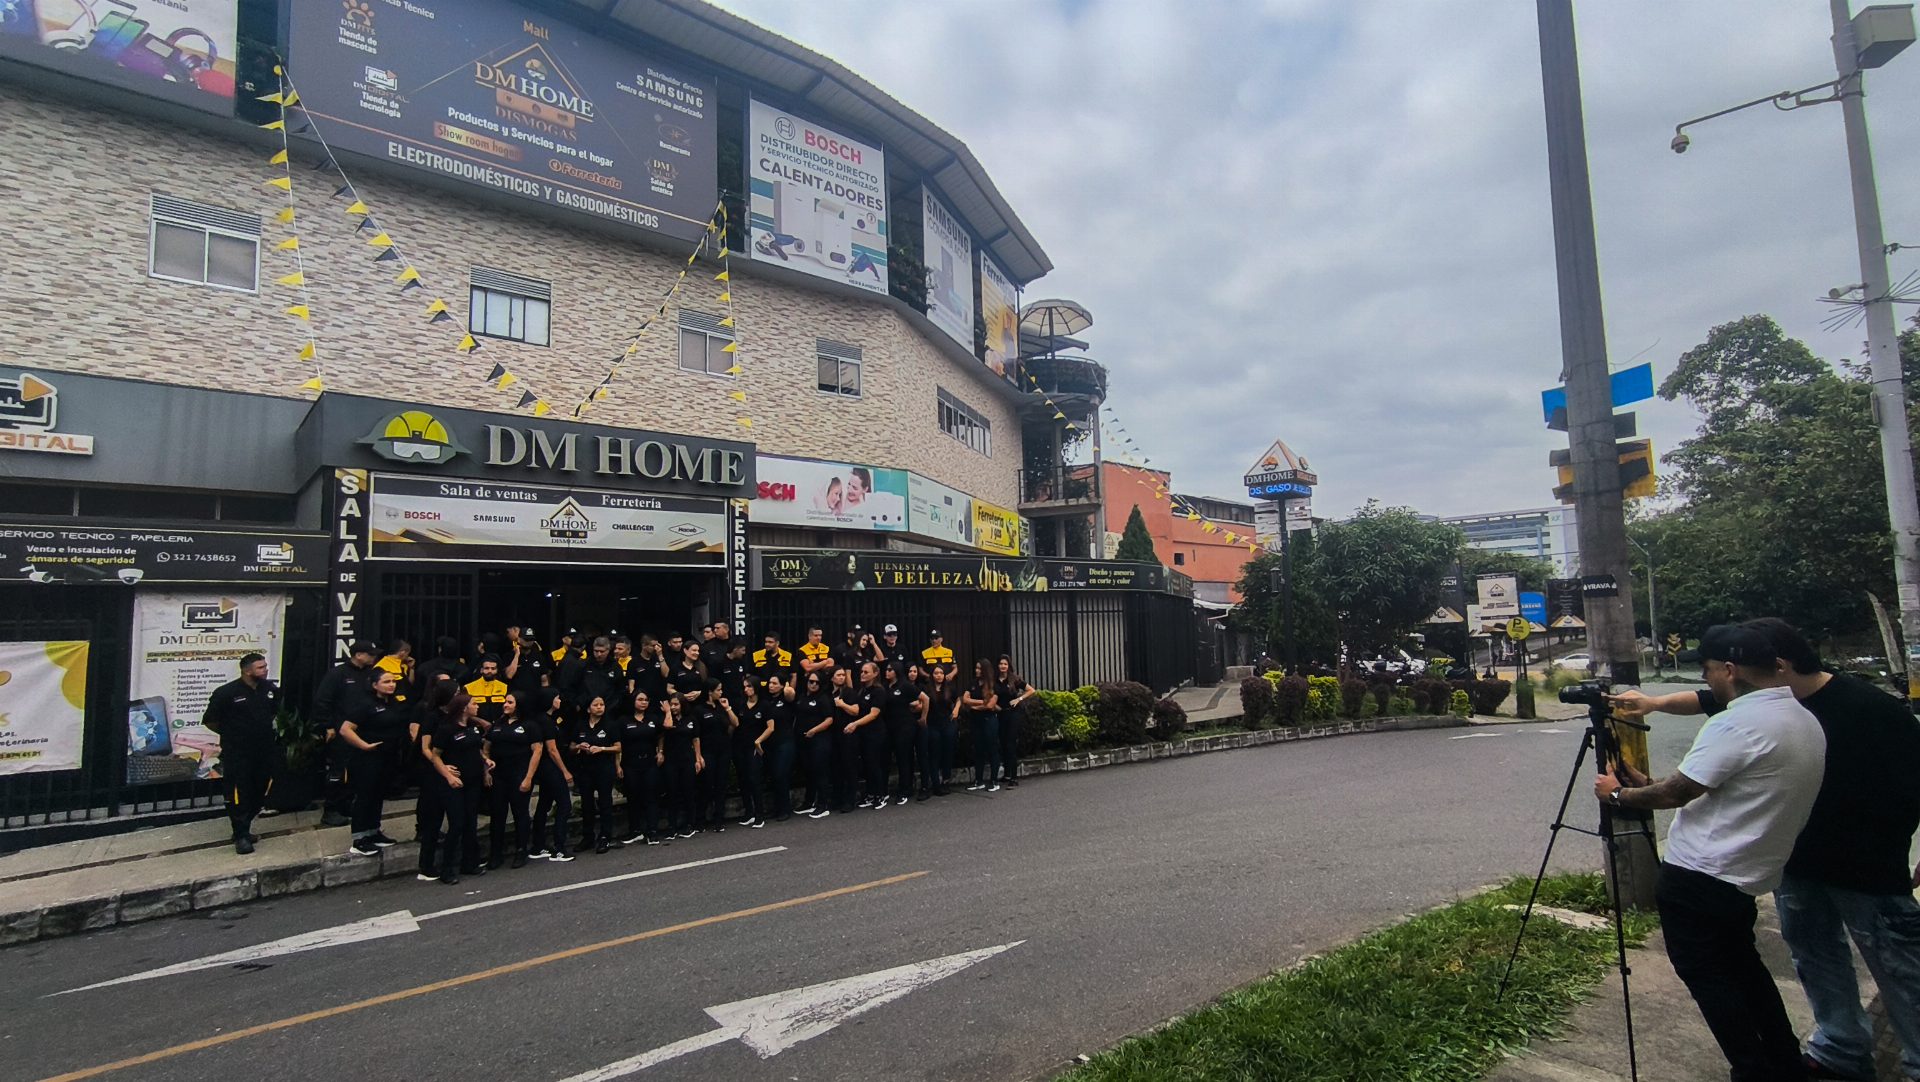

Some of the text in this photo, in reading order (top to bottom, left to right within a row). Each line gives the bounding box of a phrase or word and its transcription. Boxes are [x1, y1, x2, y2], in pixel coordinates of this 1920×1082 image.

[339, 26, 365, 42] Tienda
[523, 20, 549, 40] Mall
[338, 37, 377, 54] mascotas
[474, 60, 594, 118] DM HOME
[636, 74, 703, 108] SAMSUNG
[362, 91, 388, 106] Tienda
[495, 105, 577, 141] DISMOGAS
[438, 124, 462, 140] Show
[466, 135, 490, 149] room
[448, 107, 614, 168] Productos y Servicios para el hogar
[804, 129, 862, 164] BOSCH
[768, 148, 802, 164] SERVICIO
[836, 173, 879, 193] AUTORIZADO
[836, 162, 878, 184] DIRECTO
[388, 141, 659, 228] ELECTRODOMÉSTICOS Y GASODOMÉSTICOS
[760, 158, 884, 212] CALENTADORES
[926, 194, 968, 253] SAMSUNG
[484, 424, 746, 486] DM HOME
[1246, 476, 1262, 484] DM
[1263, 471, 1294, 482] HOME
[440, 484, 538, 501] Sala de ventas
[756, 481, 796, 501] SCH
[1266, 483, 1292, 493] GASO
[602, 494, 662, 509] Ferretería
[338, 476, 362, 562] SALA
[404, 511, 441, 520] BOSCH
[474, 514, 516, 523] SAMSUNG
[540, 519, 597, 530] DM HOME
[612, 524, 654, 532] CHALLENGER
[27, 545, 56, 553] Venta
[68, 546, 122, 554] instalación
[86, 556, 135, 565] seguridad
[194, 554, 236, 562] 7438652
[781, 560, 800, 570] DM
[340, 573, 356, 582] DE
[874, 571, 974, 585] Y BELLEZA
[1513, 619, 1521, 628] P
[160, 634, 260, 645] DM DIGITAL
